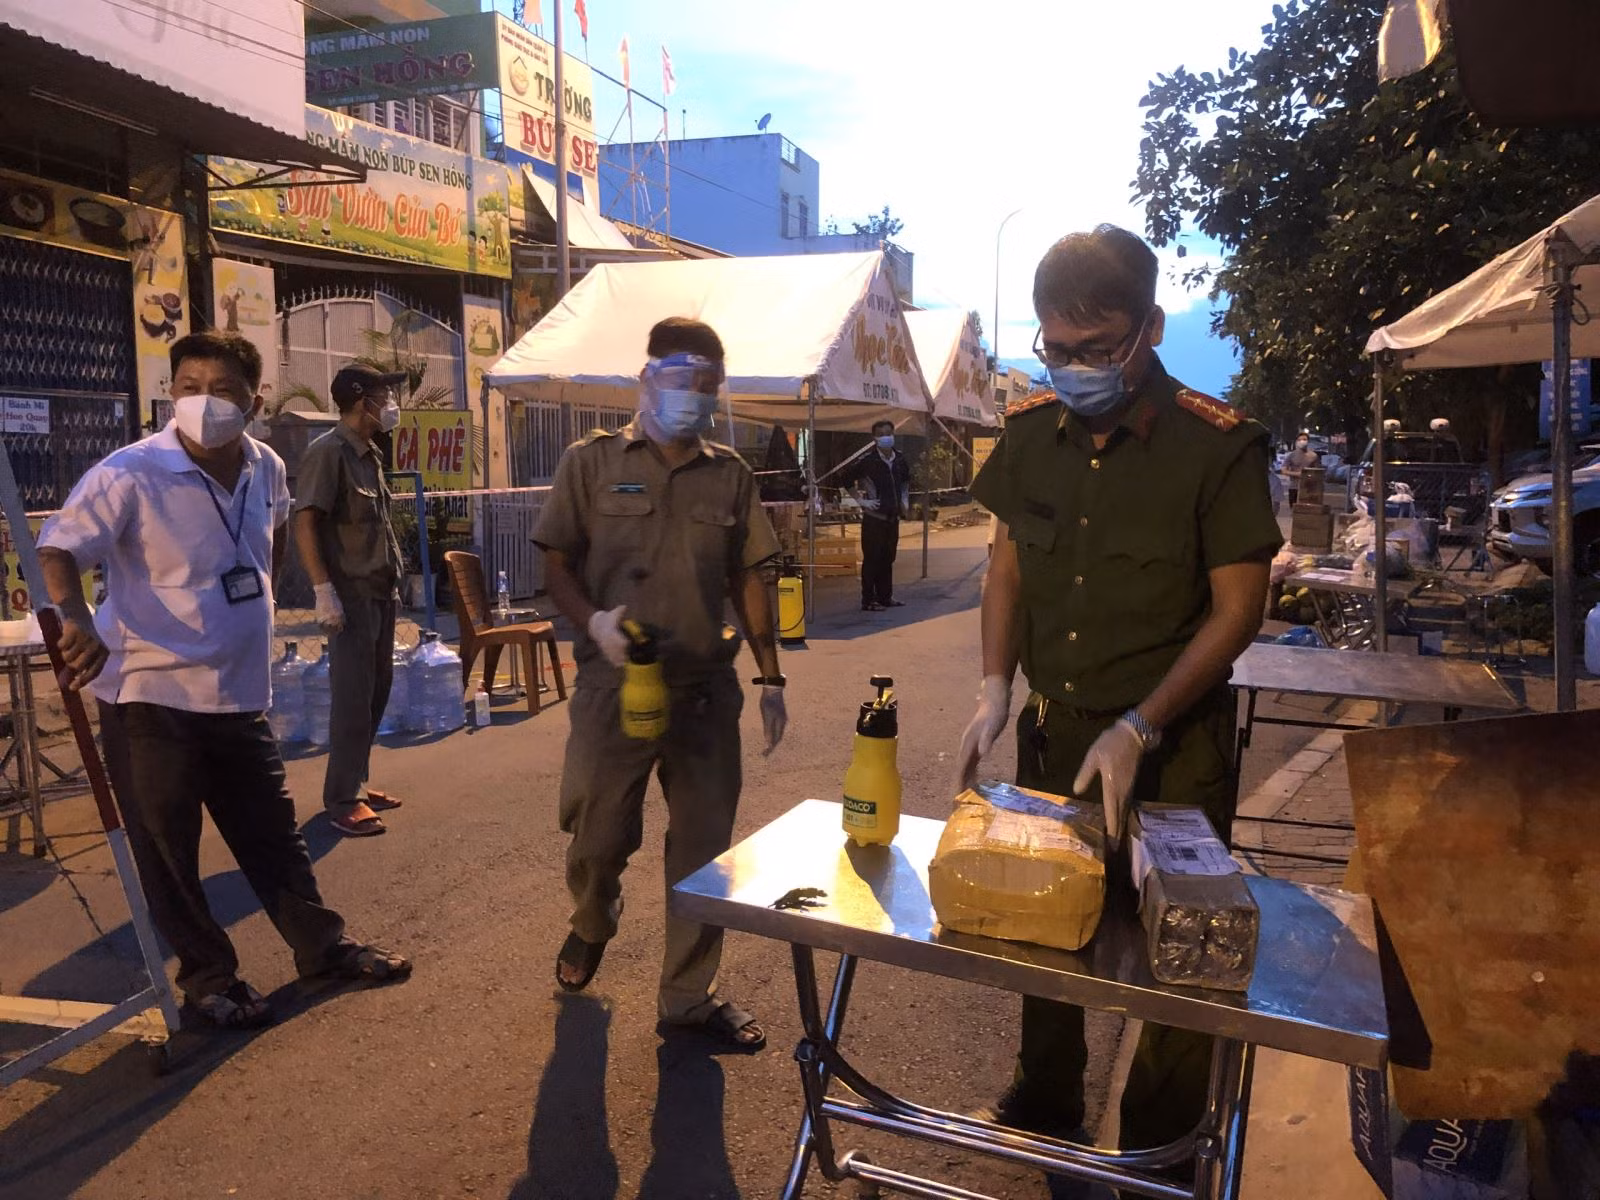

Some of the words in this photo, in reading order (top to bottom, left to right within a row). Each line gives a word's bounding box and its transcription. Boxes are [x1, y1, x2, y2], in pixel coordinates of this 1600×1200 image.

[309, 38, 336, 56] NG
[390, 27, 430, 45] NON
[534, 71, 592, 121] TRỜNG
[306, 131, 325, 148] NG
[363, 146, 390, 170] NON
[392, 153, 416, 177] BÚP
[419, 162, 440, 183] SEN
[443, 162, 473, 191] HỒNG
[520, 110, 554, 154] BÚ
[571, 135, 598, 174] SE
[394, 192, 431, 239] Của
[434, 202, 462, 246] Bé
[396, 415, 419, 472] CÀ
[426, 416, 466, 473] PHÊ
